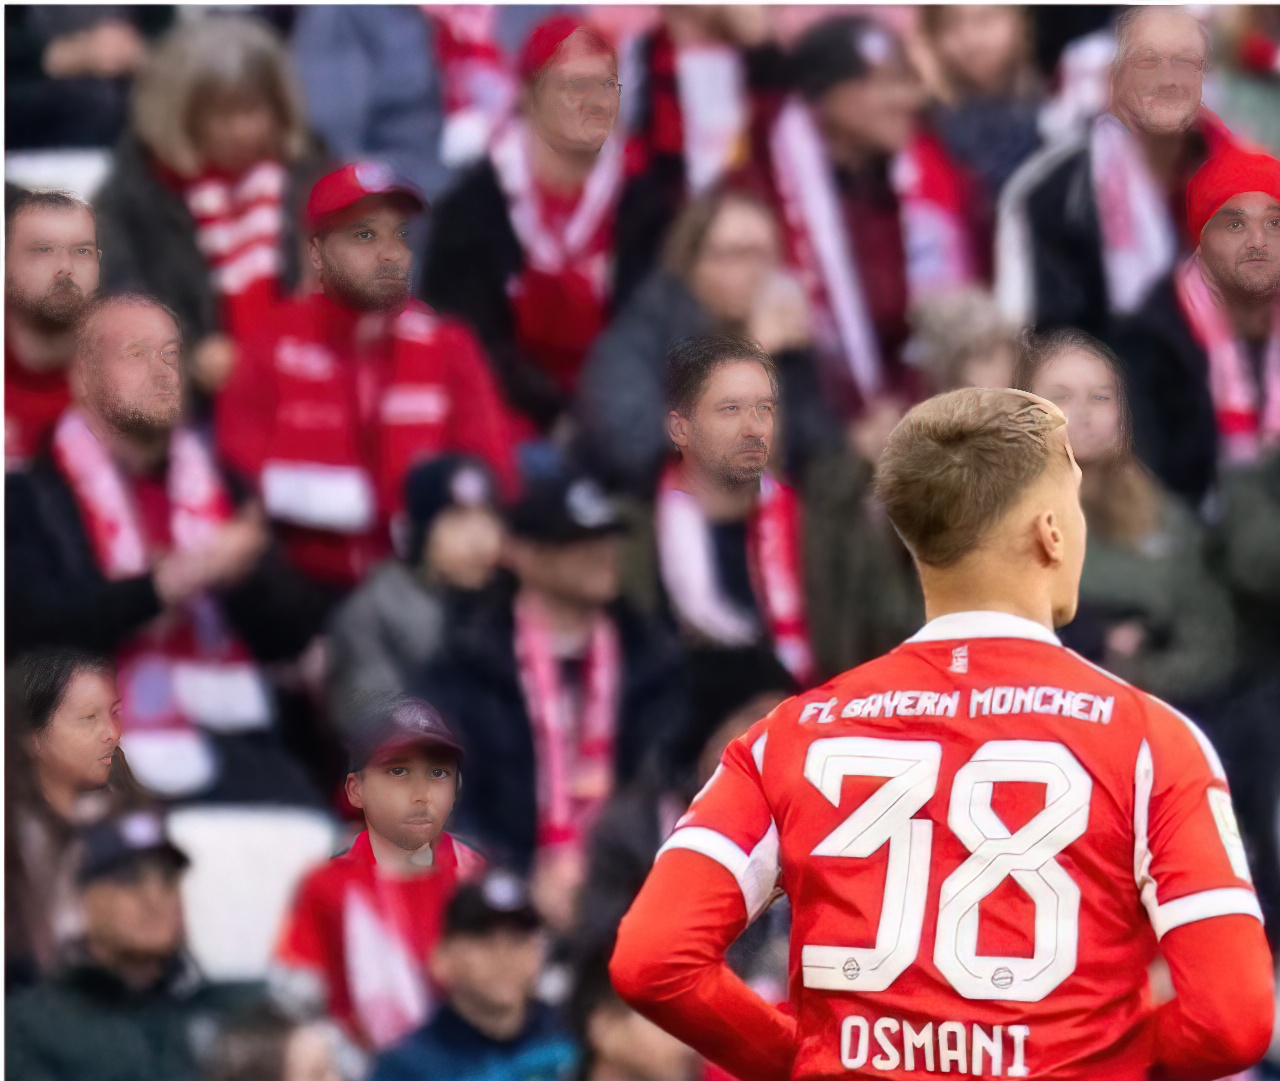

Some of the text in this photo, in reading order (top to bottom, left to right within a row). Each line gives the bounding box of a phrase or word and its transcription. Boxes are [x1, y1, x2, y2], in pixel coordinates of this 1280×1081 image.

[798, 697, 838, 724] FC
[841, 690, 960, 718] BAYERN
[802, 736, 1092, 1001] 38
[841, 1015, 1030, 1077] OSMANI
